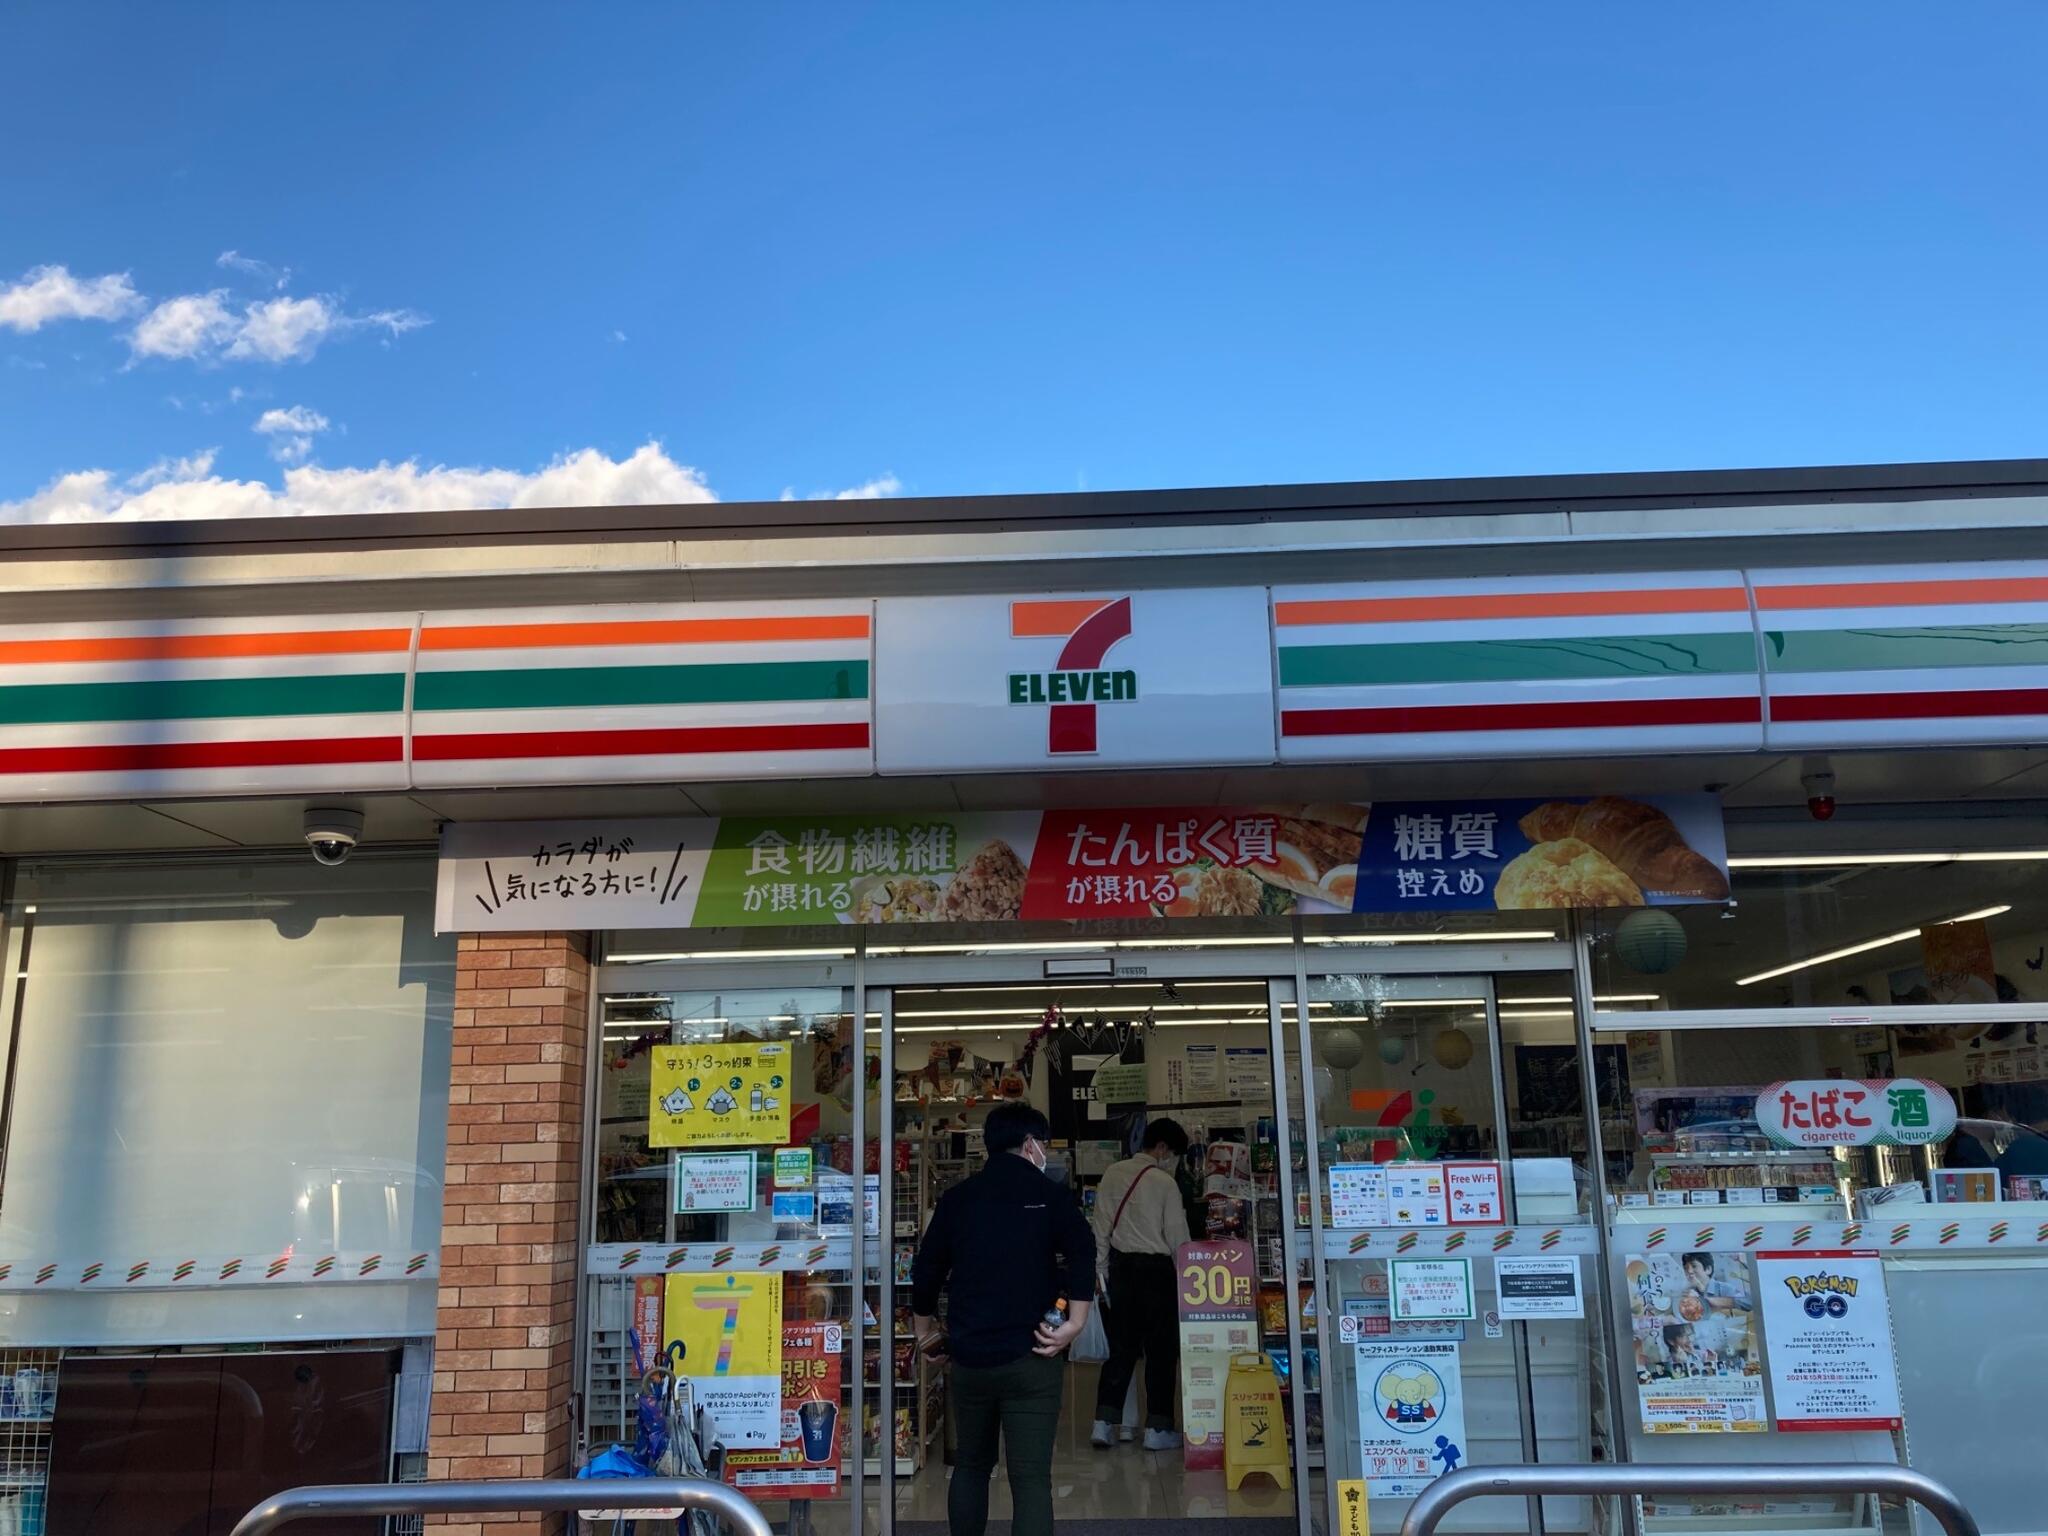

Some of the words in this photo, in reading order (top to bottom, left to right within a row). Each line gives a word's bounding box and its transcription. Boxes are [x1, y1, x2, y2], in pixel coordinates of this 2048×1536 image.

[744, 824, 957, 876] 食物繊維
[1066, 815, 1278, 868] たんぱく質
[1394, 811, 1499, 862] 糖質
[532, 837, 634, 868] カラダが
[1066, 873, 1178, 906] が摂れる
[1396, 867, 1485, 898] 控えめ
[742, 882, 852, 913] が摂れる
[1072, 1087, 1099, 1101] ELE
[1779, 1088, 1872, 1129] たばこ
[1887, 1088, 1930, 1128] 酒
[1801, 1131, 1856, 1143] cigarette
[1896, 1130, 1933, 1142] liquor
[1451, 1174, 1470, 1184] Free
[1471, 1173, 1497, 1184] Wi-Fi
[1187, 1249, 1243, 1263] 対象のパン
[1804, 1295, 1849, 1319] GO
[1401, 1405, 1421, 1415] SS
[752, 1430, 767, 1440] Pay
[1373, 1457, 1386, 1467] 110
[1394, 1457, 1407, 1467] 119
